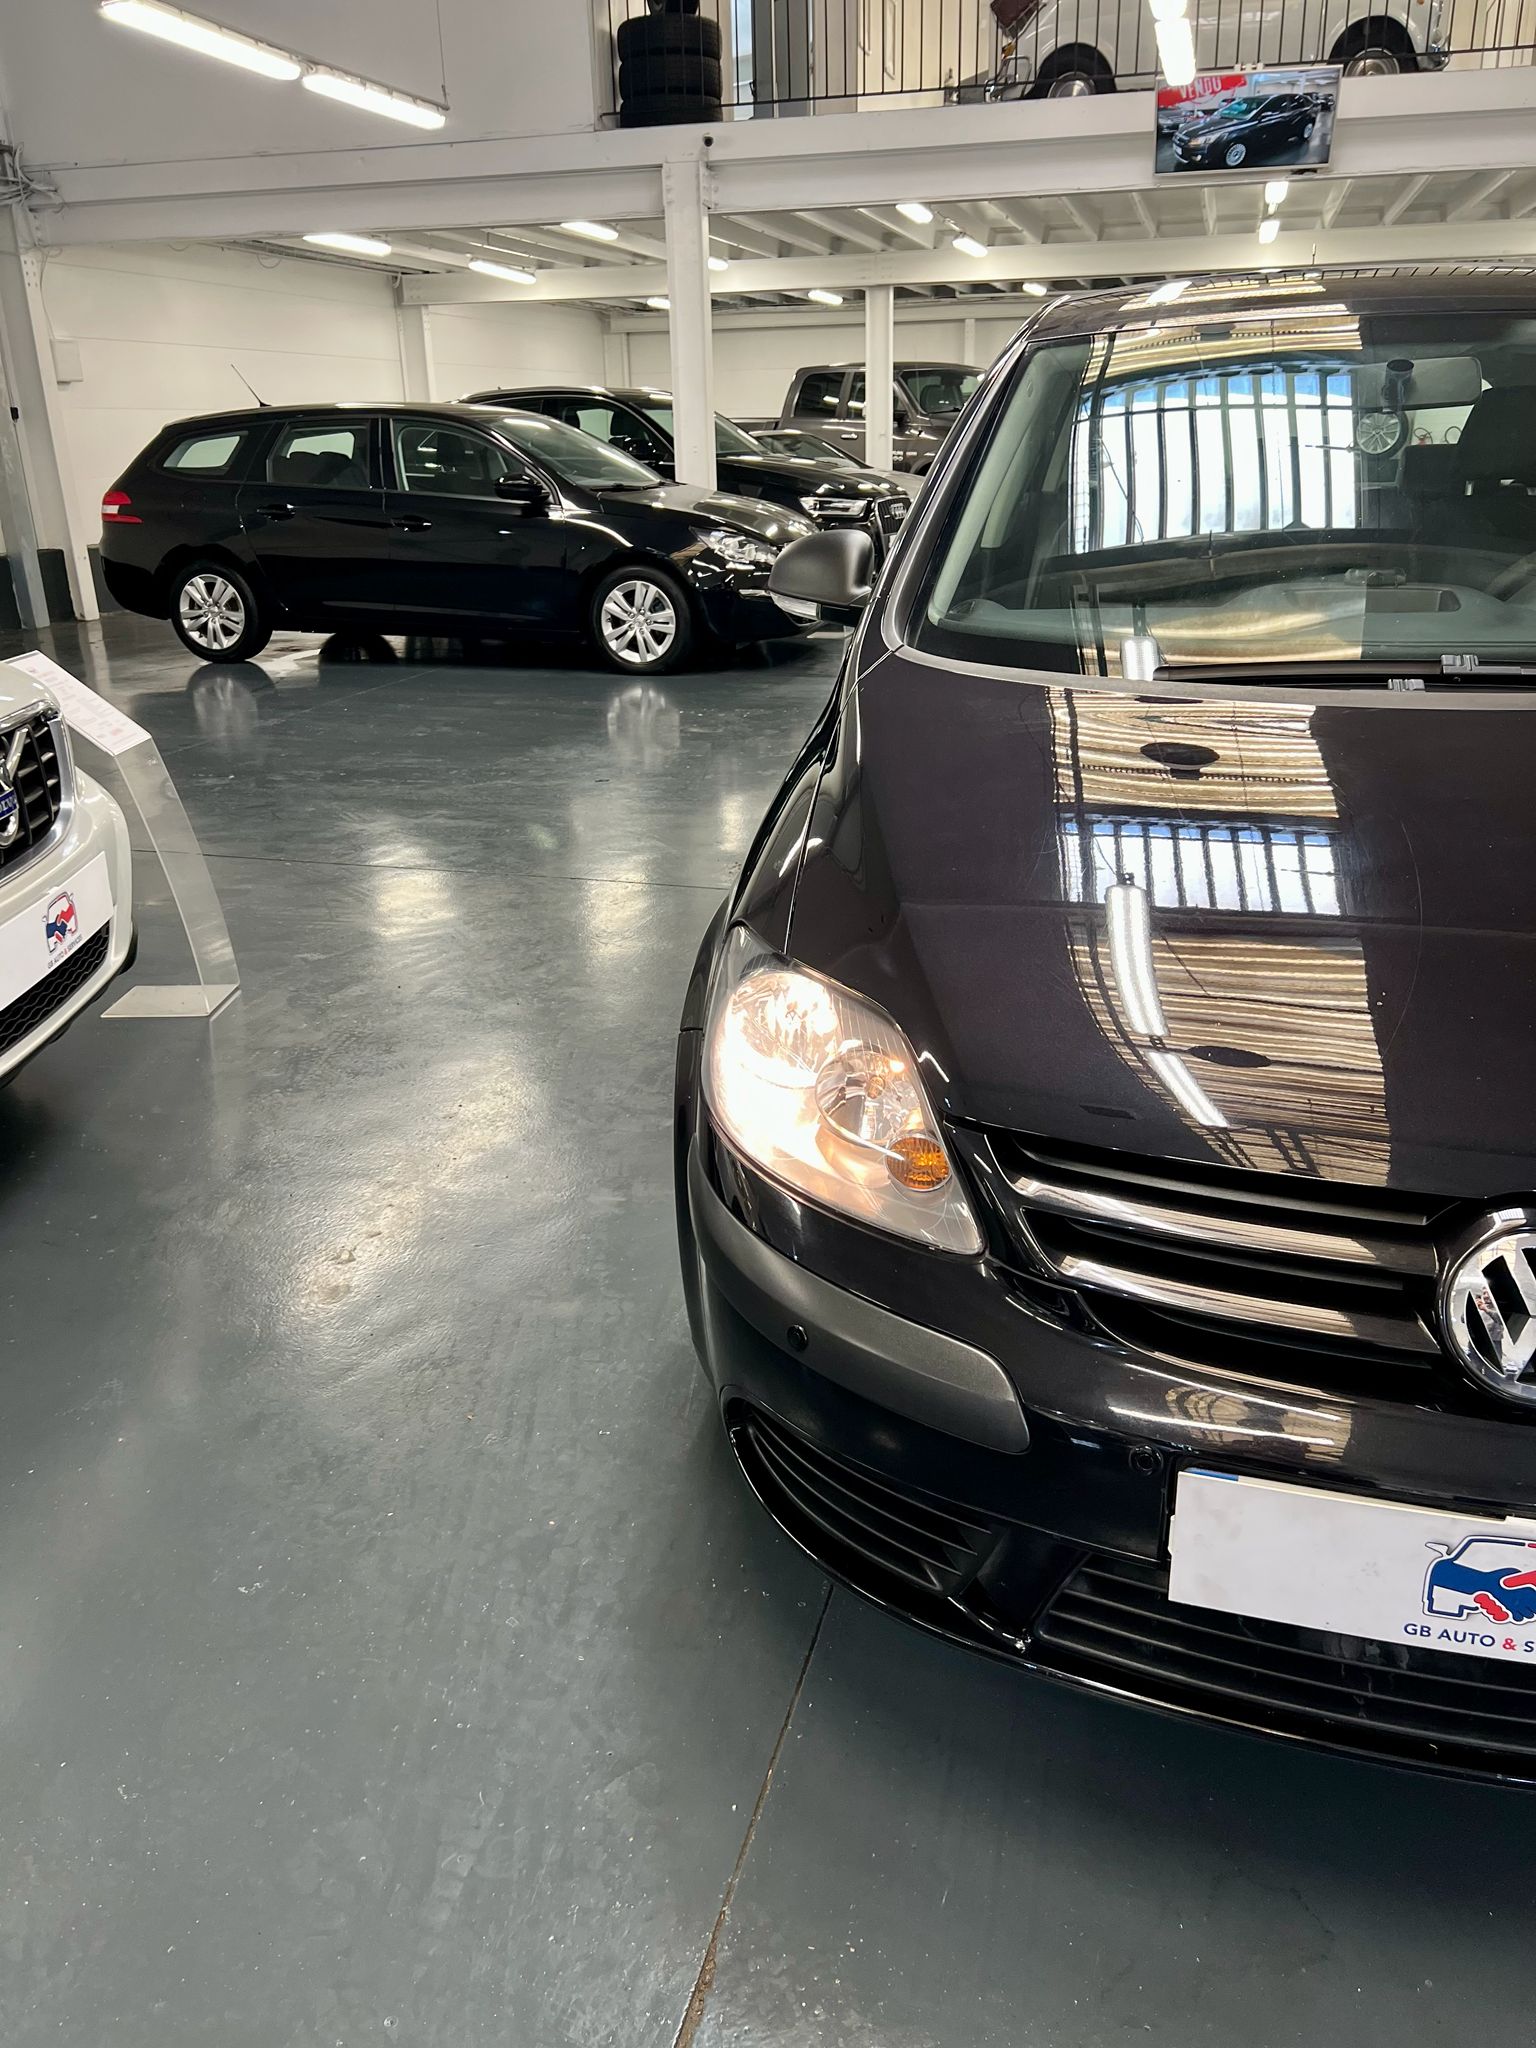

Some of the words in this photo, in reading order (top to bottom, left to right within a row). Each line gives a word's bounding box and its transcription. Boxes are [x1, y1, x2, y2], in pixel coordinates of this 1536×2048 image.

[1180, 77, 1222, 99] VENDU
[1403, 1623, 1432, 1638] GB
[1437, 1628, 1496, 1648] AUTO
[1502, 1637, 1517, 1651] &
